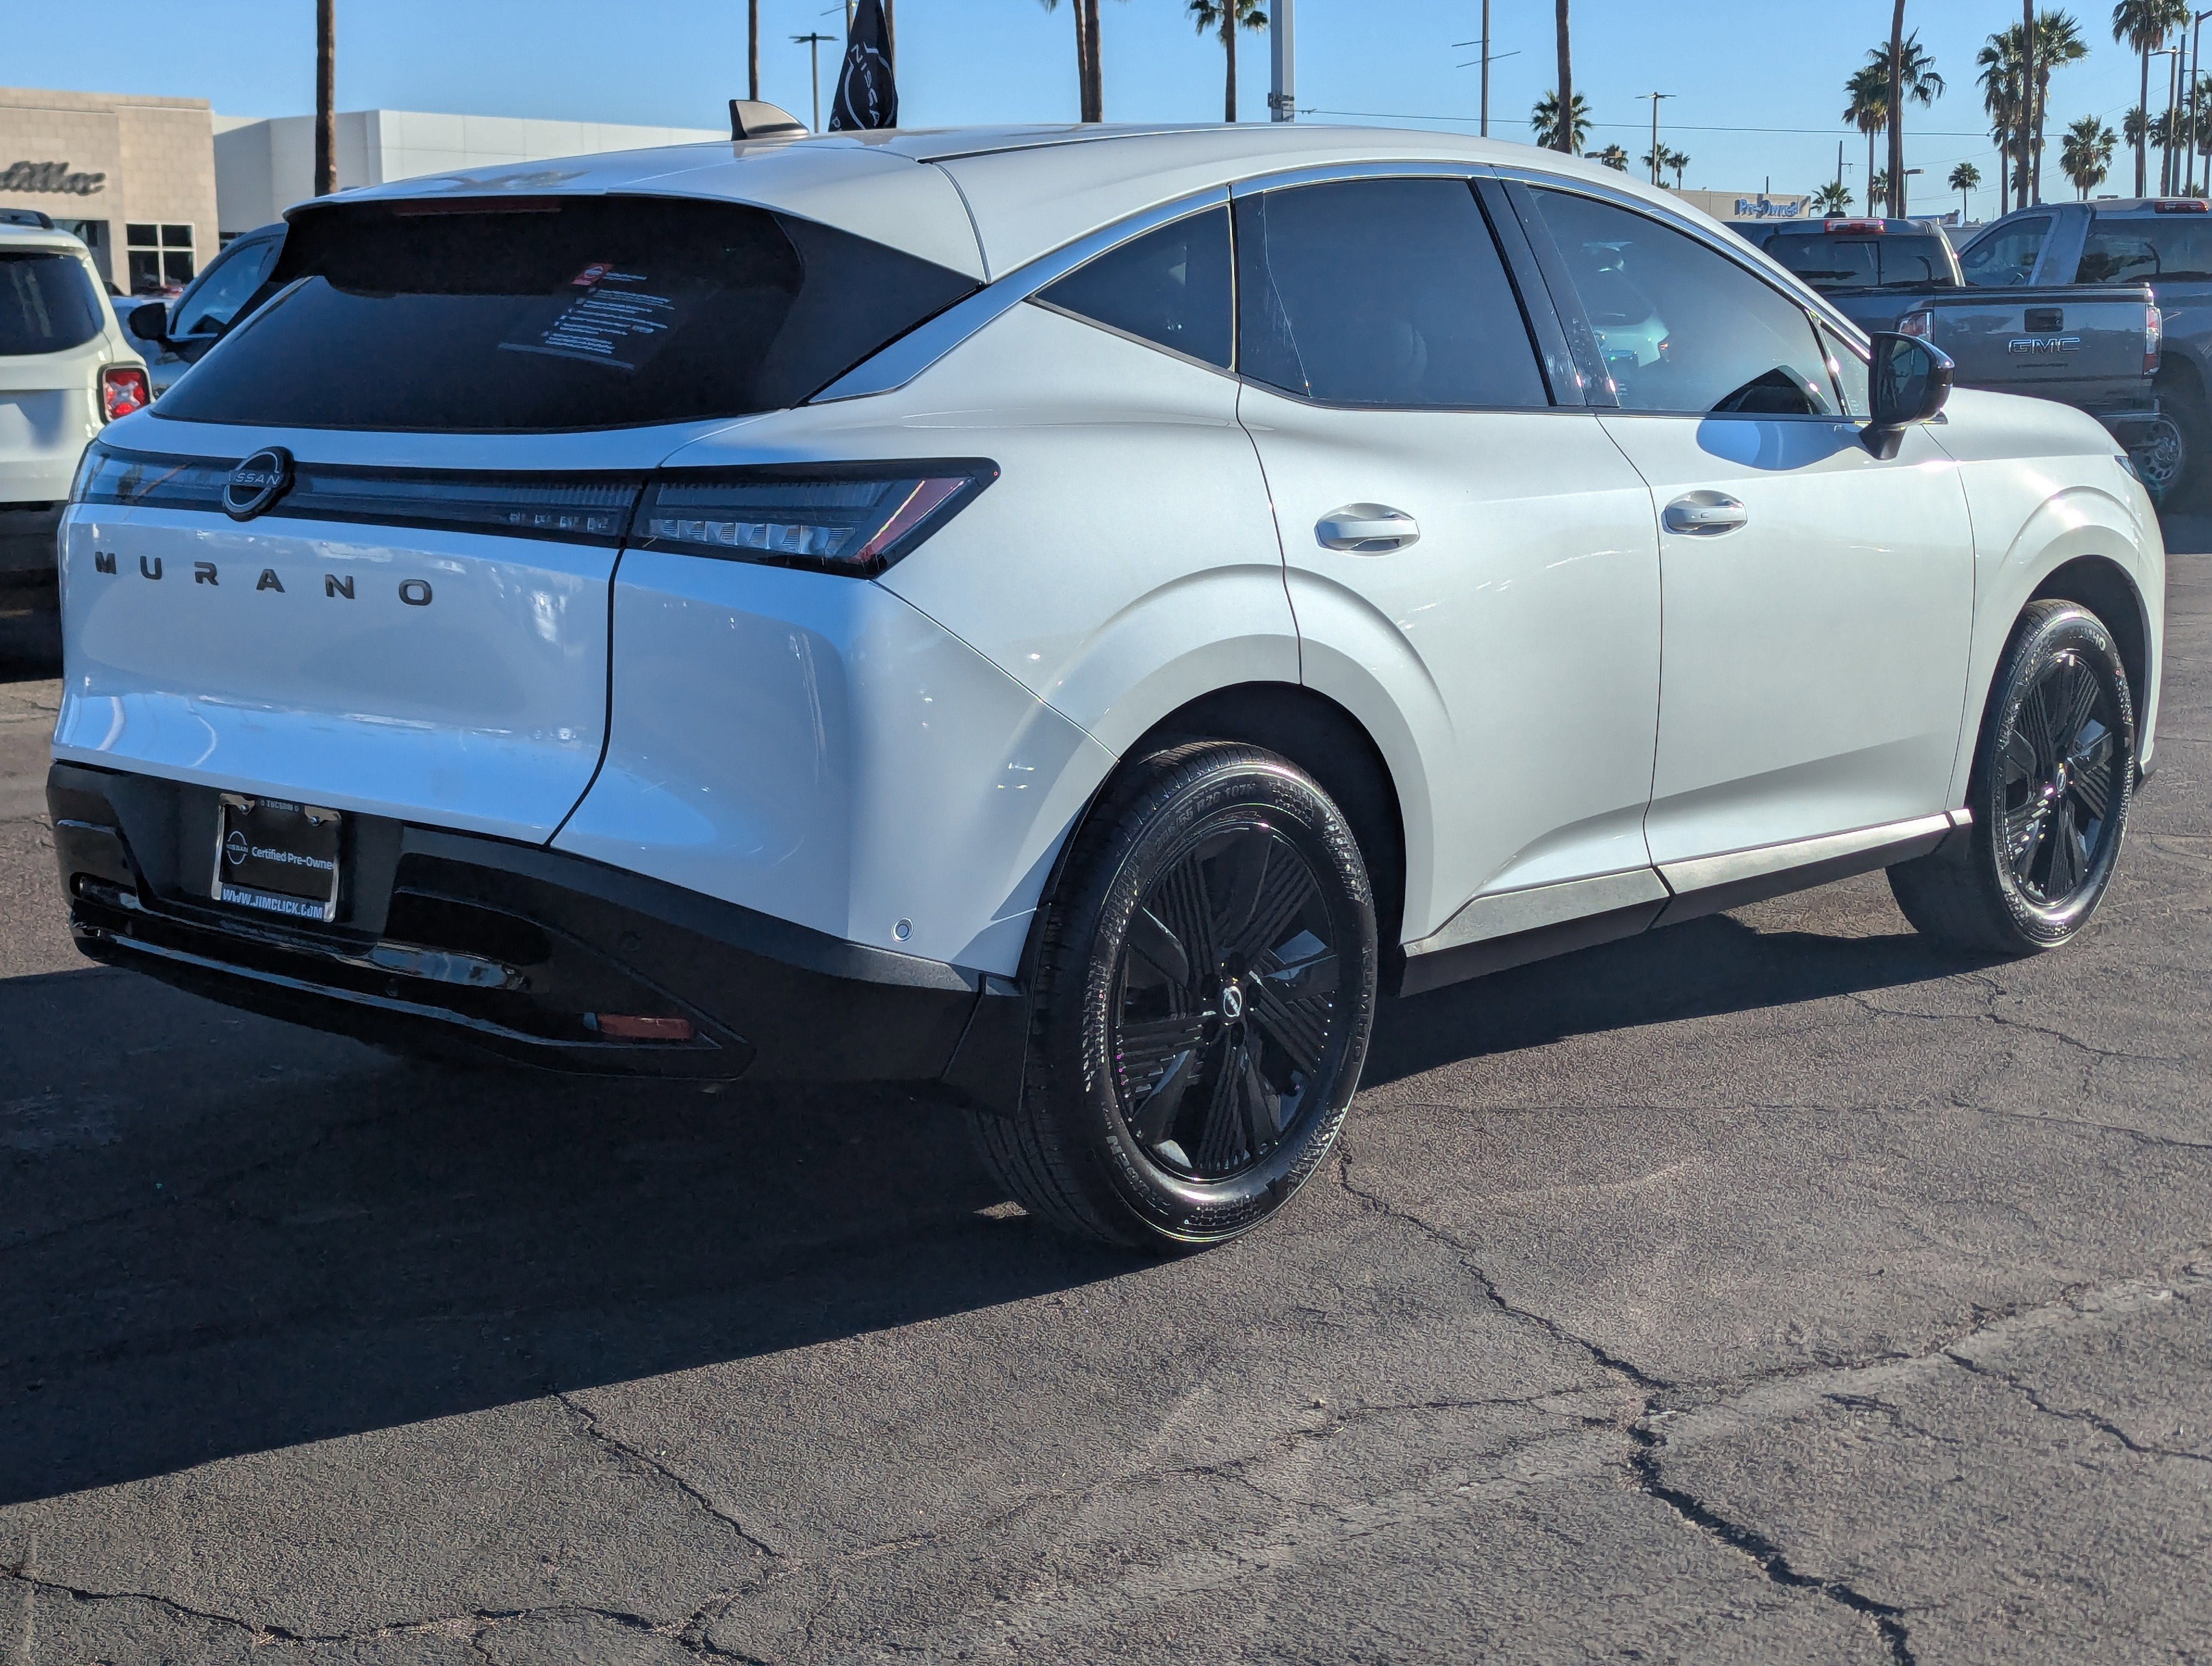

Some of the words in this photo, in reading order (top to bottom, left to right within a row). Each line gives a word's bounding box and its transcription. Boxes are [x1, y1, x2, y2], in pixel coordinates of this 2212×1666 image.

[1737, 198, 1798, 217] Pre-Owned
[2008, 337, 2081, 355] GMC
[94, 550, 433, 606] MURANO
[251, 846, 286, 862] Certified
[287, 853, 334, 870] Pre-Owne
